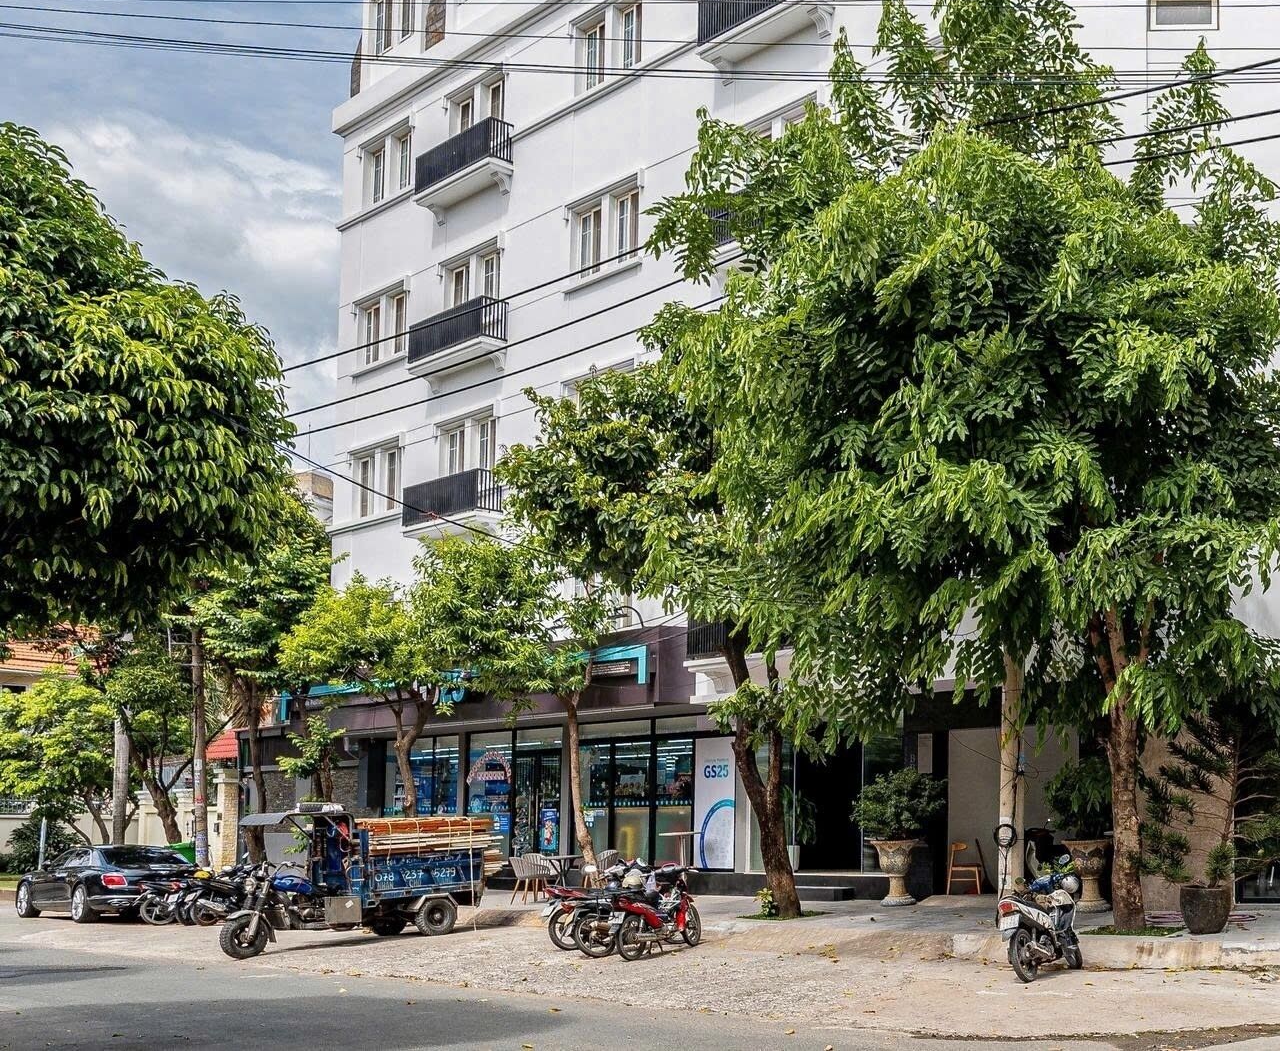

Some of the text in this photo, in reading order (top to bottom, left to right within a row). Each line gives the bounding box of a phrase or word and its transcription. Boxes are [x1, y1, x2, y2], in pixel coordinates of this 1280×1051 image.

[703, 764, 729, 779] GS25
[374, 871, 395, 882] 078
[405, 869, 424, 879] 237
